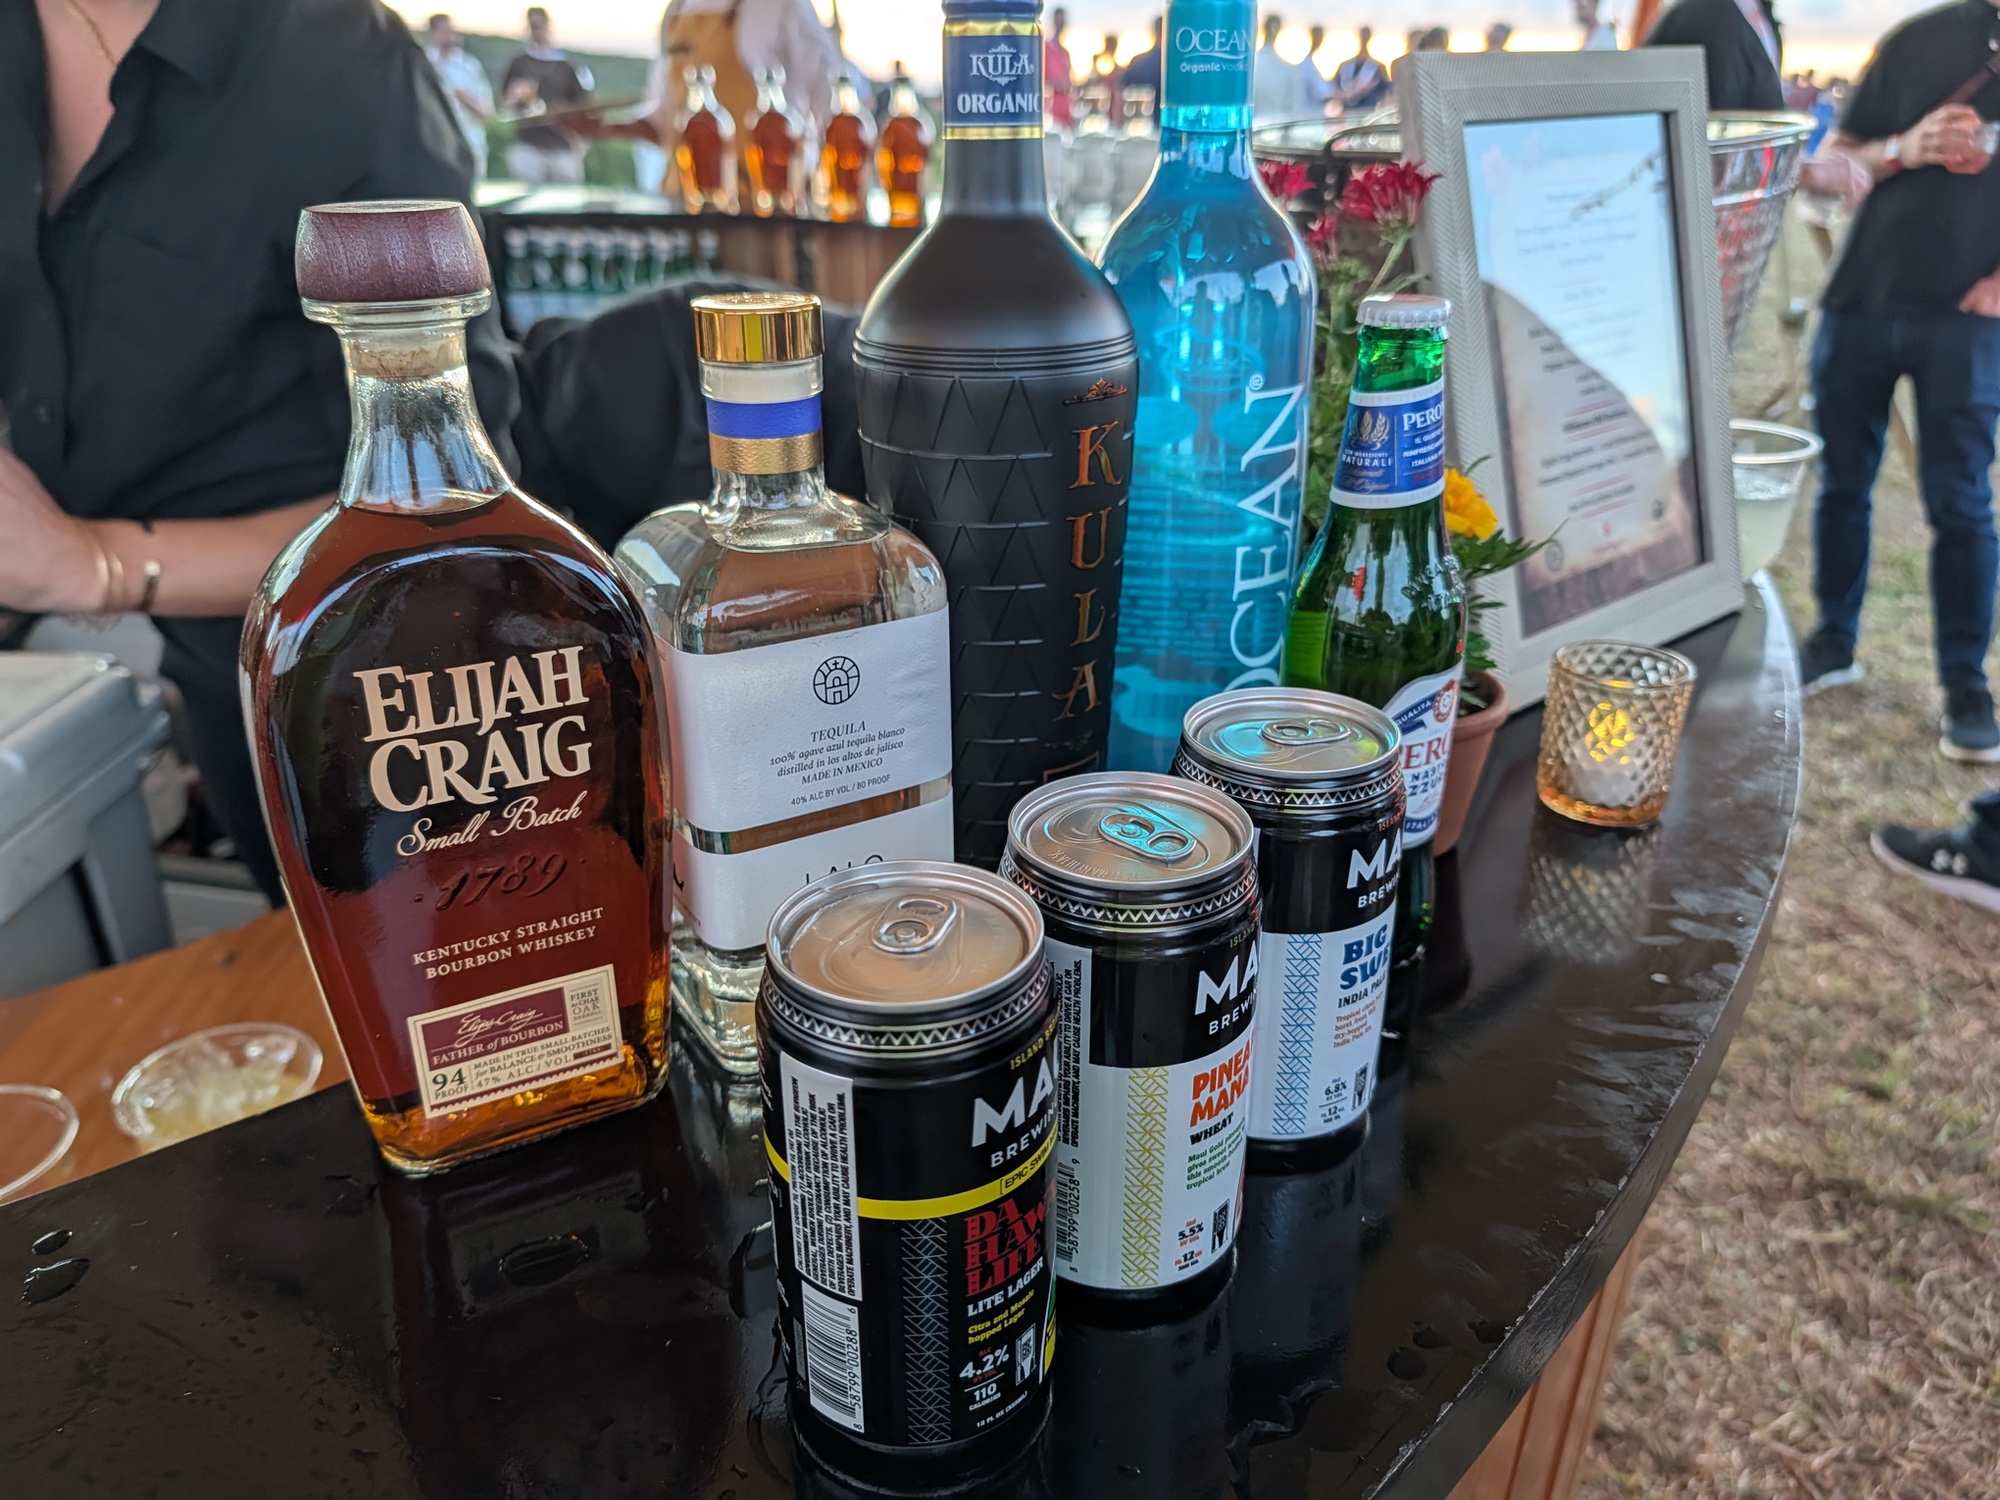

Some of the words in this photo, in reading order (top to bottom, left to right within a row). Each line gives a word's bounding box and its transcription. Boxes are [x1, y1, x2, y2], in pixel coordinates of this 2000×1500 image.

[970, 54, 1034, 79] KULA
[1180, 62, 1220, 74] Organic
[1342, 453, 1392, 467] NATURALI
[1052, 421, 1123, 721] KULA
[353, 646, 590, 742] ELIJAH
[769, 750, 796, 766] 100%
[798, 746, 824, 760] agave
[826, 739, 844, 752] azul
[847, 733, 876, 748] tequila
[878, 727, 905, 740] blanco
[810, 720, 867, 743] TEQUILA
[370, 715, 592, 813] CRAIG
[777, 759, 814, 777] distilled
[816, 759, 825, 768] in
[828, 754, 840, 765] los
[842, 750, 863, 762] altos
[864, 746, 875, 756] de
[875, 740, 904, 756] jalisco
[801, 770, 831, 785] MADE
[833, 767, 844, 776] IN
[845, 757, 883, 774] MEXICO
[791, 794, 807, 806] 40%
[809, 791, 824, 801] ALC
[825, 788, 835, 797] BY
[836, 784, 850, 795] VOL
[857, 780, 866, 790] 80
[867, 774, 891, 787] PROOF
[397, 811, 490, 857] Small
[491, 790, 588, 836] Batch
[435, 853, 568, 912] 1789
[412, 929, 512, 965] KENTUCKY
[515, 907, 604, 939] STRAIGHT
[1342, 923, 1388, 966] BIG
[425, 947, 513, 980] BOURBON
[517, 926, 598, 955] WHISKEY
[570, 988, 598, 1002] FIRST
[572, 1001, 600, 1015] OAK
[1338, 987, 1369, 1008] INDIA
[432, 1043, 484, 1066] FATHER
[487, 1037, 500, 1051] of
[500, 1020, 564, 1046] BOURBON
[473, 1058, 501, 1070] MADE
[503, 1055, 514, 1065] IN
[514, 1048, 539, 1062] TRUE
[541, 1037, 570, 1051] SMALL
[571, 1026, 611, 1041] BATCHES
[489, 1056, 537, 1074] BALANCE
[546, 1034, 612, 1058] SMOOTHNESS
[1010, 1037, 1044, 1070] ISLAND
[432, 1067, 467, 1092] 94
[477, 1075, 502, 1088] 47%
[507, 1065, 533, 1080] ALC
[545, 1055, 571, 1069] VOL
[434, 1085, 469, 1100] PROOF
[809, 1112, 817, 1127] THE
[827, 1102, 835, 1114] OR
[828, 1114, 836, 1131] CAR
[1328, 1105, 1338, 1116] 12
[810, 1127, 818, 1139] OF
[818, 1106, 827, 1150] ALCOHOLIC
[1190, 1111, 1234, 1146] WHEAT
[811, 1139, 820, 1173] BECAUSE
[820, 1150, 828, 1160] OF
[829, 1139, 838, 1162] DRIVE
[838, 1136, 848, 1164] HEALTH
[1188, 1149, 1207, 1163] Maui
[1209, 1139, 1224, 1153] Gold
[831, 1163, 838, 1172] TO
[840, 1164, 850, 1189] CAUSE
[1186, 1171, 1215, 1190] tropical
[1216, 1159, 1230, 1176] brew
[1186, 1171, 1202, 1181] this
[1187, 1159, 1207, 1173] gives
[814, 1173, 823, 1218] PREGNANCY
[821, 1160, 832, 1213] CONSUMPTION
[831, 1173, 840, 1203] ABILITY
[842, 1189, 851, 1207] MAY
[1068, 1178, 1080, 1215] 00258
[833, 1203, 841, 1222] YOUR
[843, 1208, 852, 1223] AND
[964, 1198, 1024, 1244] DA
[1068, 1218, 1079, 1255] 58799
[1178, 1221, 1204, 1241] 5.5%
[819, 1246, 828, 1286] BEVERAGES
[827, 1258, 835, 1280] BIRTH
[965, 1228, 1041, 1297] LIFE
[1182, 1250, 1195, 1263] 12
[828, 1280, 836, 1289] OF
[836, 1253, 845, 1294] BEVERAGES
[845, 1265, 855, 1297] OPERATE
[967, 1290, 1005, 1317] LITE
[1007, 1256, 1043, 1298] LAGER
[847, 1307, 856, 1315] 6
[968, 1321, 991, 1334] Citra
[993, 1309, 1009, 1324] and
[968, 1323, 1003, 1344] hopped
[1003, 1307, 1026, 1328] Lager
[845, 1328, 859, 1368] 00288
[959, 1344, 1010, 1378] 4.2%
[848, 1371, 861, 1410] 58799
[969, 1392, 1001, 1411] CALORIES
[974, 1383, 997, 1401] 110
